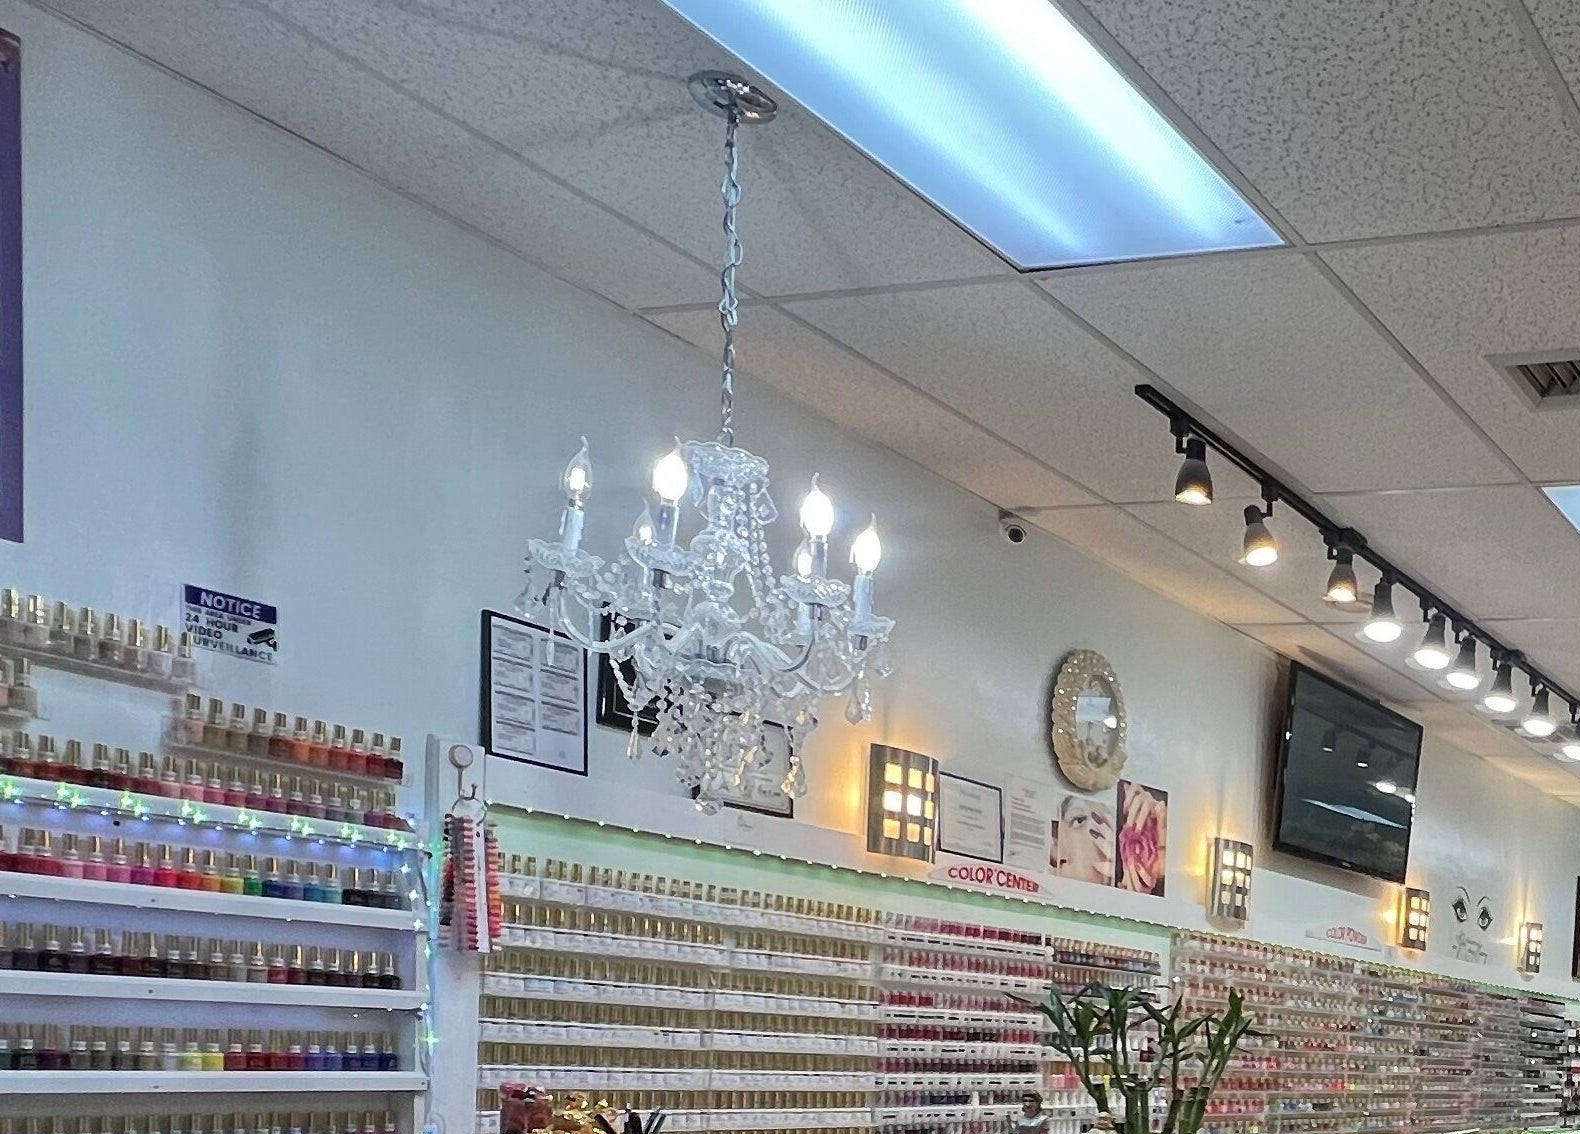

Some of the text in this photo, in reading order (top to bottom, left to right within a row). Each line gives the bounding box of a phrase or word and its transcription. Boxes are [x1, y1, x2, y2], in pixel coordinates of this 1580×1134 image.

[200, 591, 262, 619] NOTICE
[185, 613, 239, 633] 24 HOUR
[185, 623, 223, 640] VIDEO
[192, 634, 273, 661] URVEILLANCE
[947, 867, 1040, 893] COLOR CENTER
